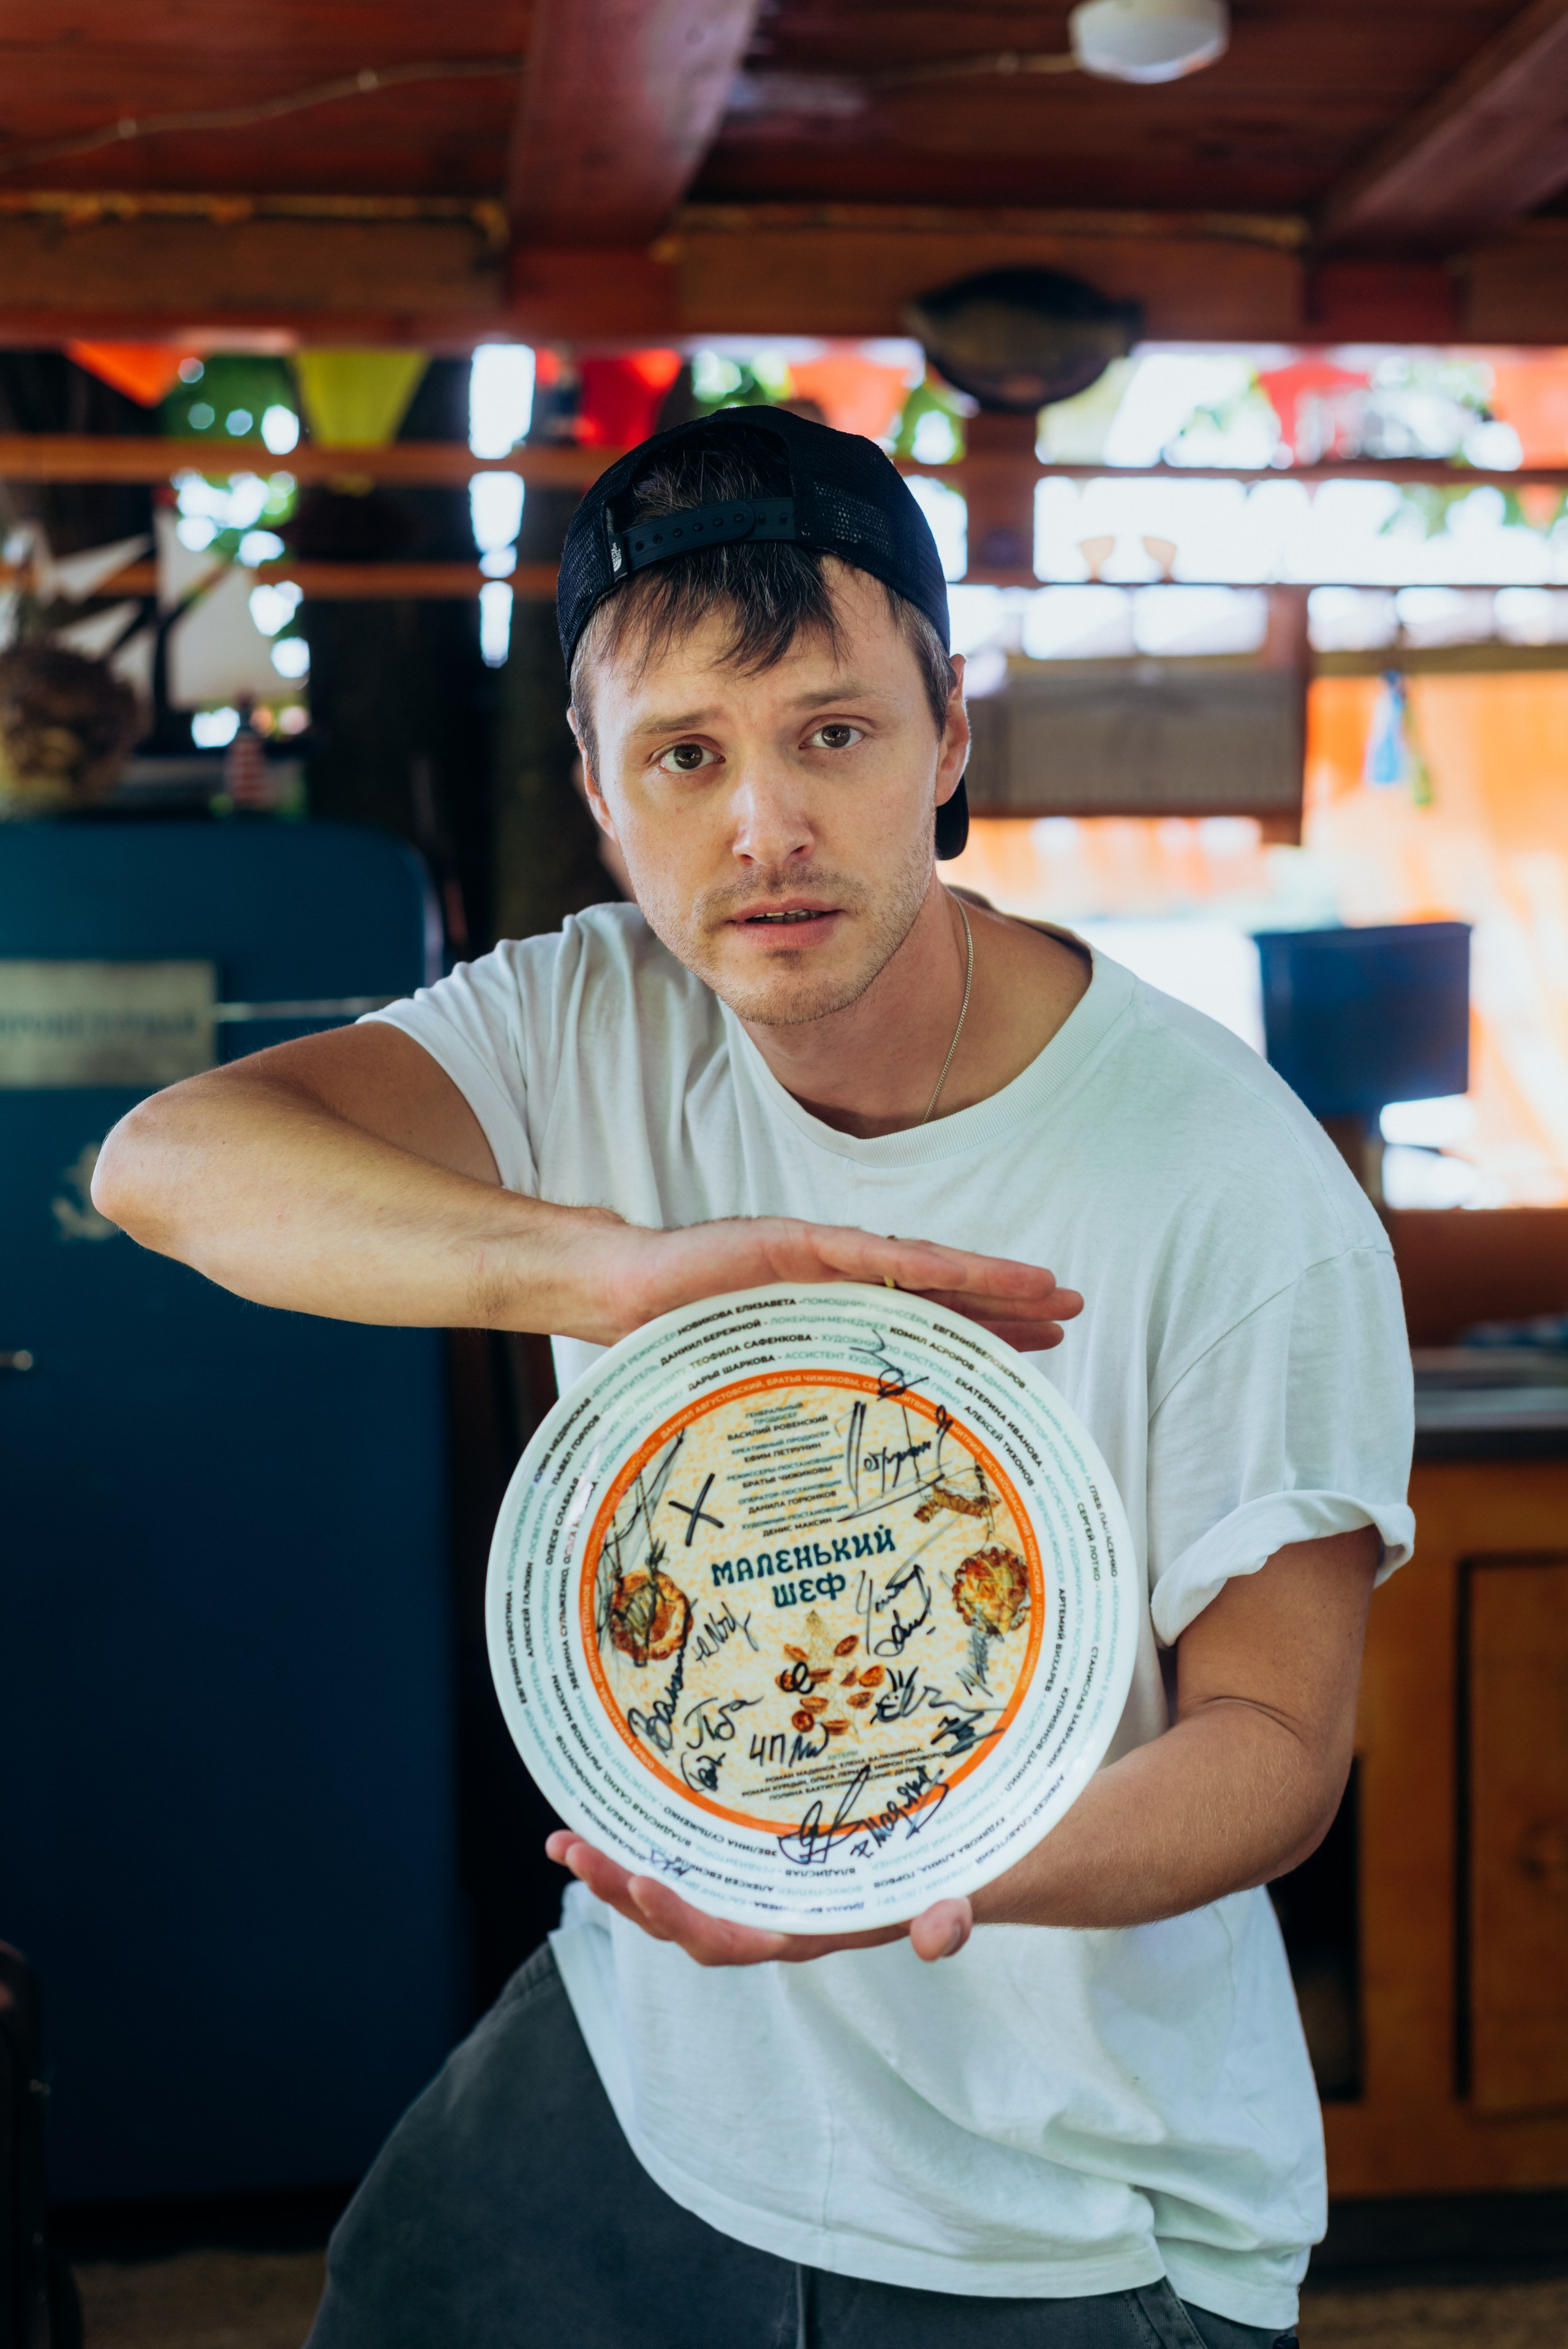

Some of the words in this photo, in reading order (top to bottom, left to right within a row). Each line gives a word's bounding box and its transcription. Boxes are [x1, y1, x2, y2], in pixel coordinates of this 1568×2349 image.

[676, 1308, 733, 1335] НОВИКОВА
[736, 1298, 796, 1314] ЕЛИЗАВЕТА
[703, 1321, 761, 1343] БЕРЕЖНОЙ
[743, 1333, 812, 1349] САФЕНКОВА
[889, 1327, 927, 1346] КОМИЛ
[658, 1338, 703, 1365] ДАНИИЛ
[688, 1344, 741, 1370] ТЕОФИЛА
[722, 1355, 775, 1375] ШАРКОВА
[784, 1352, 844, 1361] АССИСТЕНТ
[884, 1344, 900, 1355] ПО
[686, 1370, 720, 1391] ДАРЬЯ
[693, 1380, 764, 1414] АВГУСТОВСКИЙ,
[766, 1375, 801, 1387] БРАТЬЯ
[804, 1375, 861, 1387] ЧИЖИКОВЫ,
[954, 1376, 1008, 1422] ЕКАТЕРИНА
[547, 1396, 592, 1452] МЕДЯНСКАЯ
[638, 1411, 654, 1426] ПО
[659, 1409, 695, 1439] ДАНИИЛ
[727, 1426, 771, 1441] ВАСИЛИЙ
[774, 1415, 828, 1431] РОВЕНСКИЙ
[962, 1405, 1002, 1443] АЛЕКСЕЙ
[732, 1439, 784, 1455] КРЕАТИВНЫЙ
[744, 1452, 771, 1463] ЕФИМ
[774, 1442, 821, 1456] ПЕТРУНИН
[1005, 1420, 1044, 1468] ИВАНОВА
[530, 1452, 551, 1482] ЮЛИЯ
[549, 1450, 573, 1485] ПАВЕЛ
[742, 1476, 776, 1488] БРАТЬЯ
[778, 1466, 832, 1481] ЧИЖИКОВЫ
[1000, 1442, 1034, 1487] ТИХОНОВ
[748, 1501, 785, 1514] ДАНИЛА
[1042, 1473, 1073, 1533] АССИСТЕНТ
[1088, 1484, 1104, 1510] ГЛЕБ
[763, 1525, 792, 1537] ДЕНИС
[1076, 1502, 1094, 1542] СЕРГЕЙ
[543, 1528, 559, 1565] ОЛЕСЯ
[711, 1525, 895, 1586] МАЛЕНЬКИЙ
[1088, 1544, 1100, 1581] ЛОТКО
[1024, 1537, 1041, 1594] РОВЕНСКИЙ
[522, 1561, 532, 1604] ГАЛКИН
[772, 1572, 846, 1608] ШЕФ
[503, 1591, 515, 1655] СУББОТИНА
[582, 1583, 591, 1635] СТЕПАНОВ
[1056, 1588, 1065, 1640] АРТЕМИЙ
[1075, 1609, 1083, 1624] ПО
[522, 1608, 533, 1657] АЛЕКСЕЙ
[560, 1640, 579, 1691] ЭВЕЛИНА
[584, 1637, 602, 1683] ДМИТРИЙ
[1043, 1643, 1062, 1692] ВИХАРЕВ
[1075, 1646, 1098, 1711] СТАНИСЛАВ
[549, 1674, 573, 1722] МАКСИМ
[597, 1683, 635, 1744] КАРАБАНОВА,
[1034, 1686, 1070, 1751] КУПРИЯНОВ
[568, 1722, 603, 1772] РЫТИКОВ
[600, 1740, 614, 1757] ПО
[631, 1743, 656, 1769] ОЛЬГА
[1046, 1712, 1080, 1768] ЗАВРАЖИН
[742, 1786, 771, 1797] РОМАН
[811, 1773, 835, 1784] ОЛЬГА
[766, 1771, 794, 1782] РОМАН
[840, 1758, 866, 1769] ЕЛЕНА
[1003, 1750, 1039, 1792] ДАНИИЛ
[600, 1771, 633, 1804] САХНО,
[769, 1790, 802, 1801] ПОЛИНА
[1030, 1774, 1067, 1817] АЛЕКСЕЙ
[605, 1804, 637, 1834] ПАВЕЛ
[631, 1802, 692, 1847] ВЛАДИСЛАВ
[663, 1805, 725, 1842] СУЛЬЖЕНКО
[956, 1815, 1006, 1855] ХУДЯКОВА
[726, 1838, 777, 1856] ЭВЕЛИНА
[974, 1814, 1033, 1864] СЛАВУТСКИЙ
[785, 1866, 856, 1877] ВЛАДИСЛАВ
[916, 1850, 956, 1875] АЛИНА,
[724, 1875, 774, 1893] АЛЕКСЕЙ
